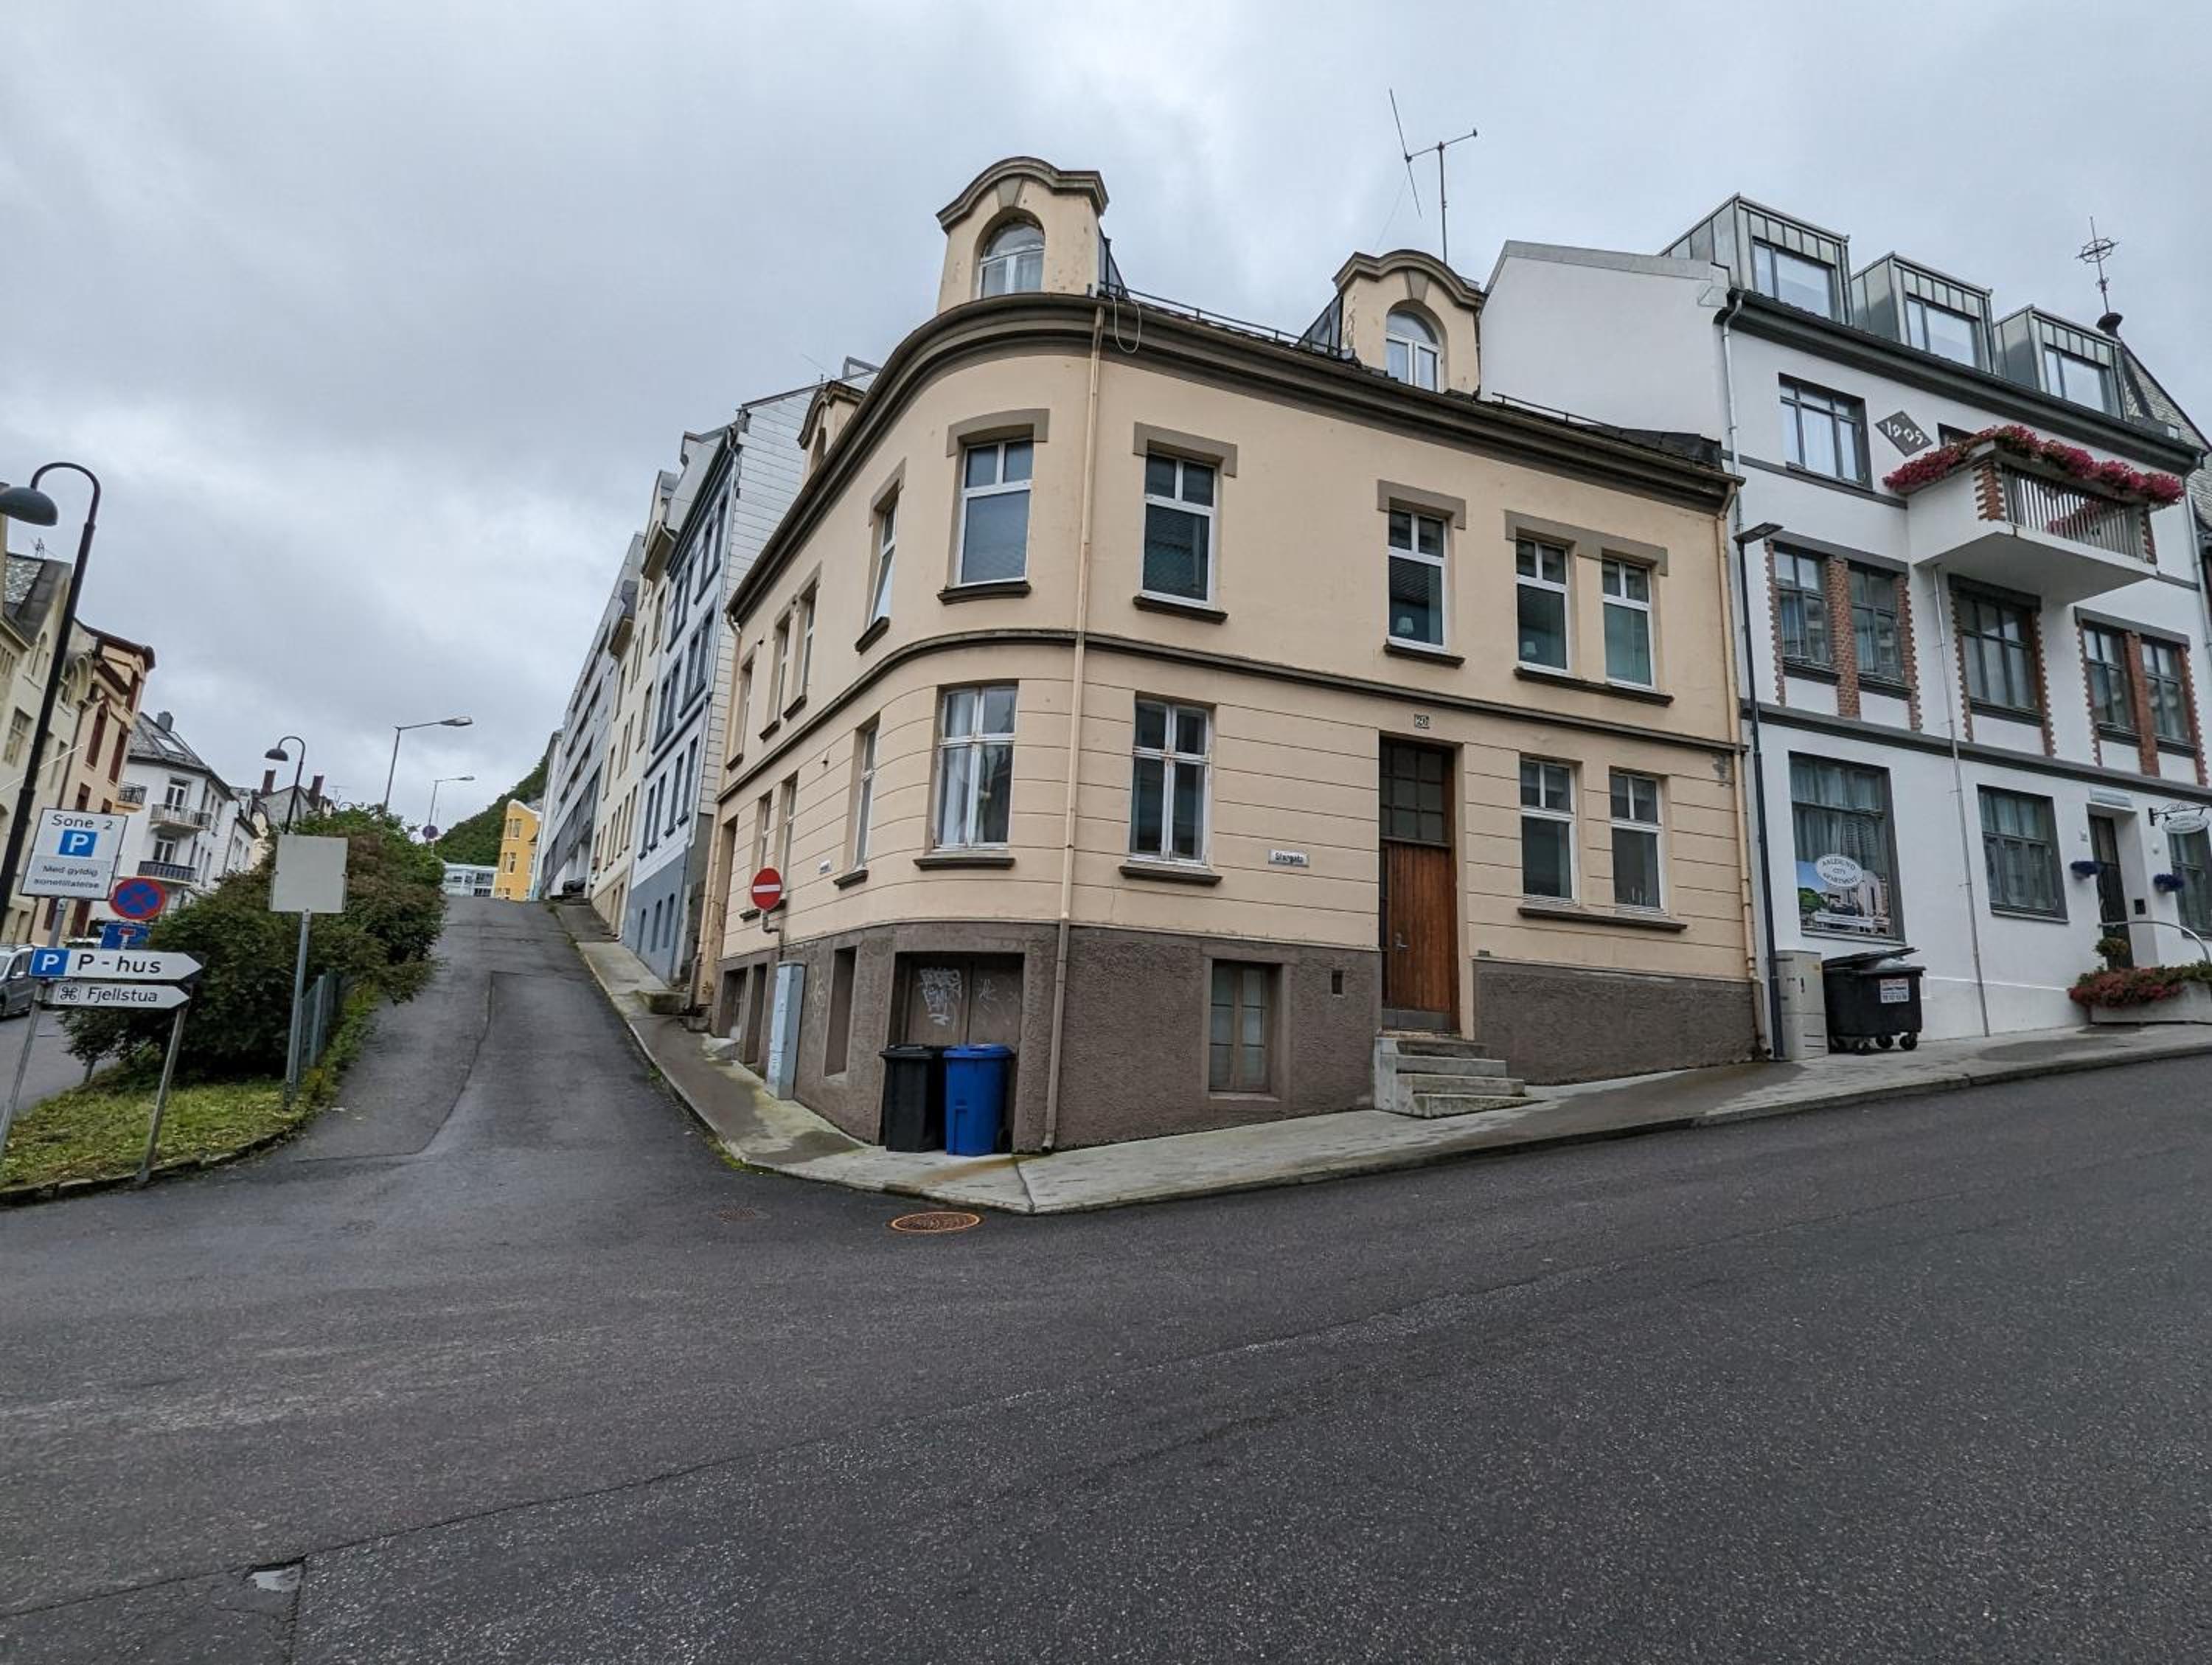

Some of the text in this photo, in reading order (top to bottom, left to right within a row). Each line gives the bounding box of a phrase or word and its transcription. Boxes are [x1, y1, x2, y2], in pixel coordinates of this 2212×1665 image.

[1887, 421, 1924, 445] 1905
[51, 813, 113, 830] Sone 2
[68, 832, 89, 853] P
[43, 865, 98, 877] Med gyldig
[41, 953, 59, 971] P
[88, 987, 157, 1003] Fjellstua
